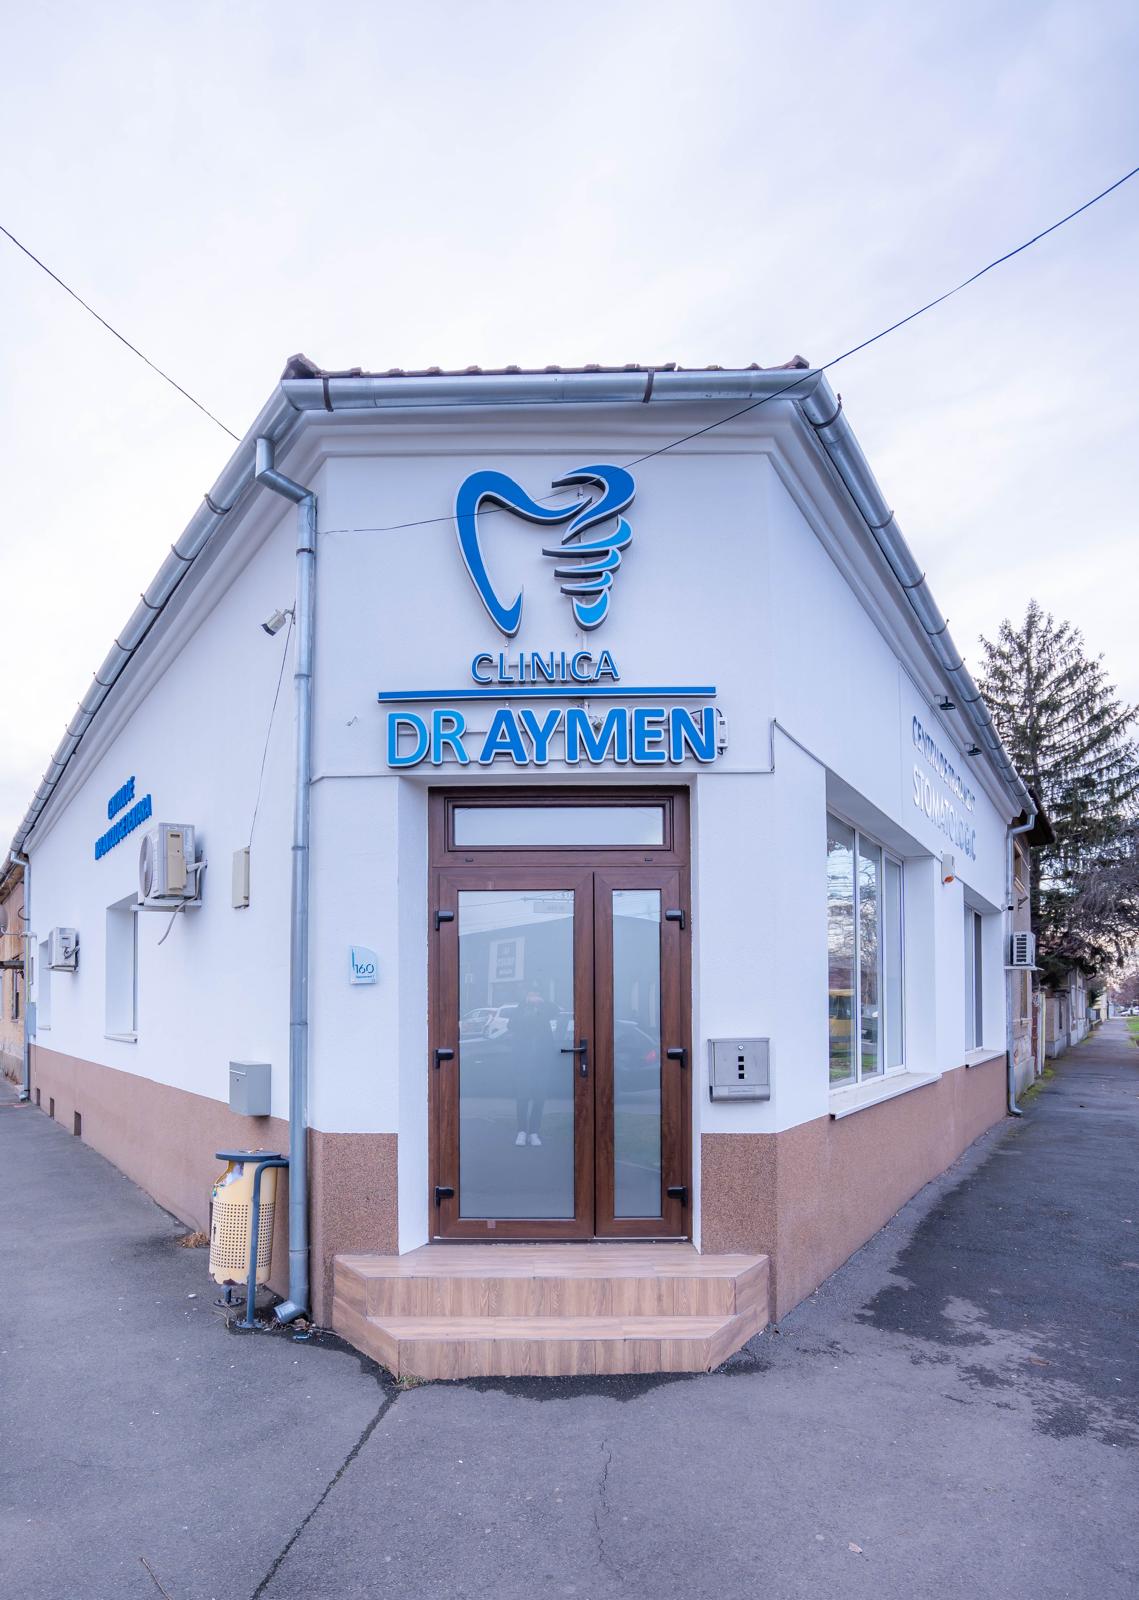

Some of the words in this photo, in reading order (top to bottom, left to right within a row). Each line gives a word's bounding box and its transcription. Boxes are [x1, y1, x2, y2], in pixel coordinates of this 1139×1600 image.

[471, 650, 620, 685] CLINICA
[386, 709, 470, 768] DR
[478, 707, 717, 766] AYMEN
[354, 963, 375, 975] 160
